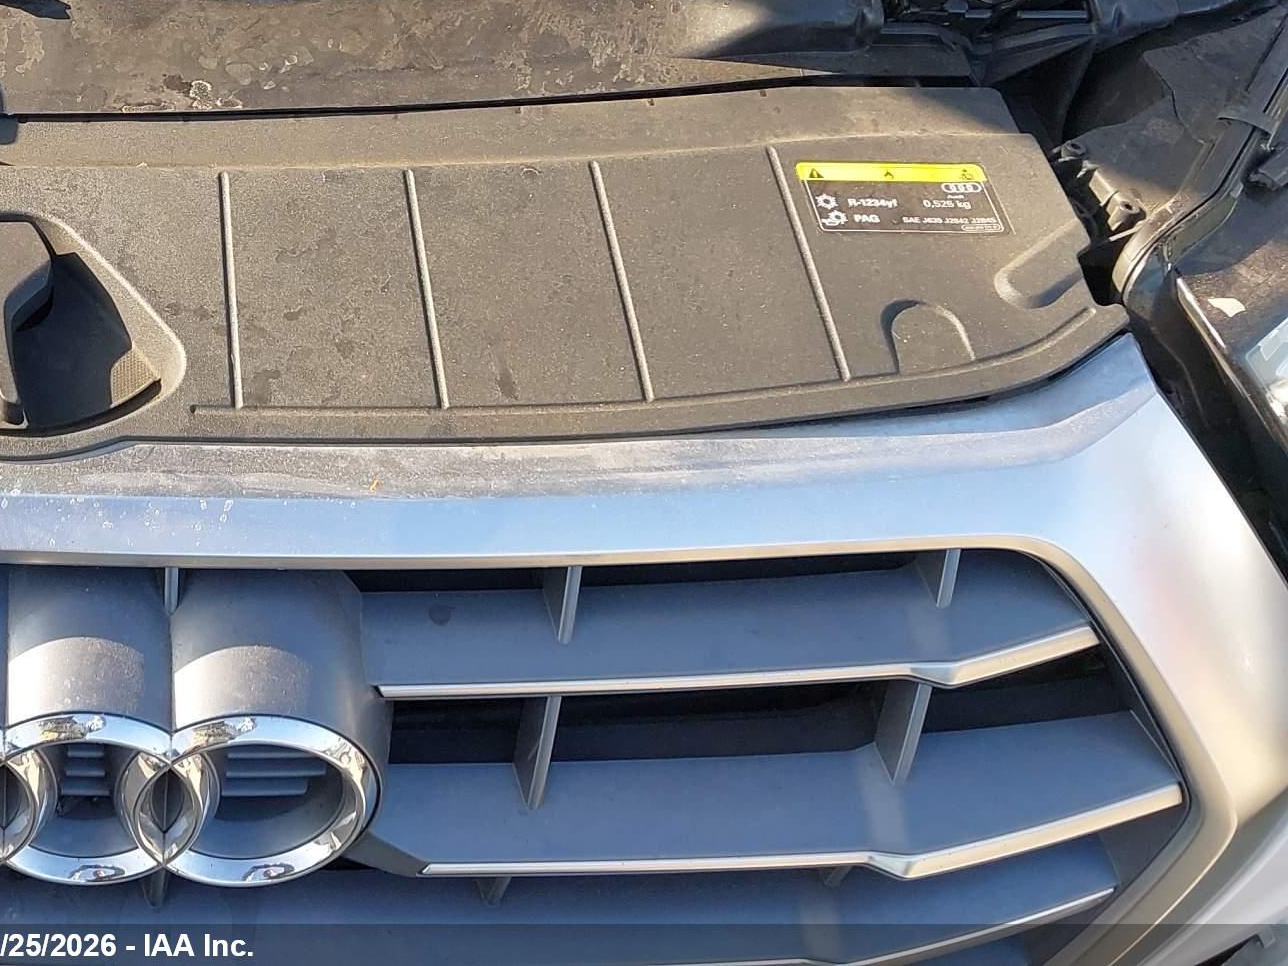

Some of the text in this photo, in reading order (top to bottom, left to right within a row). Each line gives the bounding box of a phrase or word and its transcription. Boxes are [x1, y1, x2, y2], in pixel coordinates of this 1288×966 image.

[847, 198, 898, 208] R-1234yf
[923, 199, 972, 210] 0,525 kg
[853, 214, 881, 223] PAG
